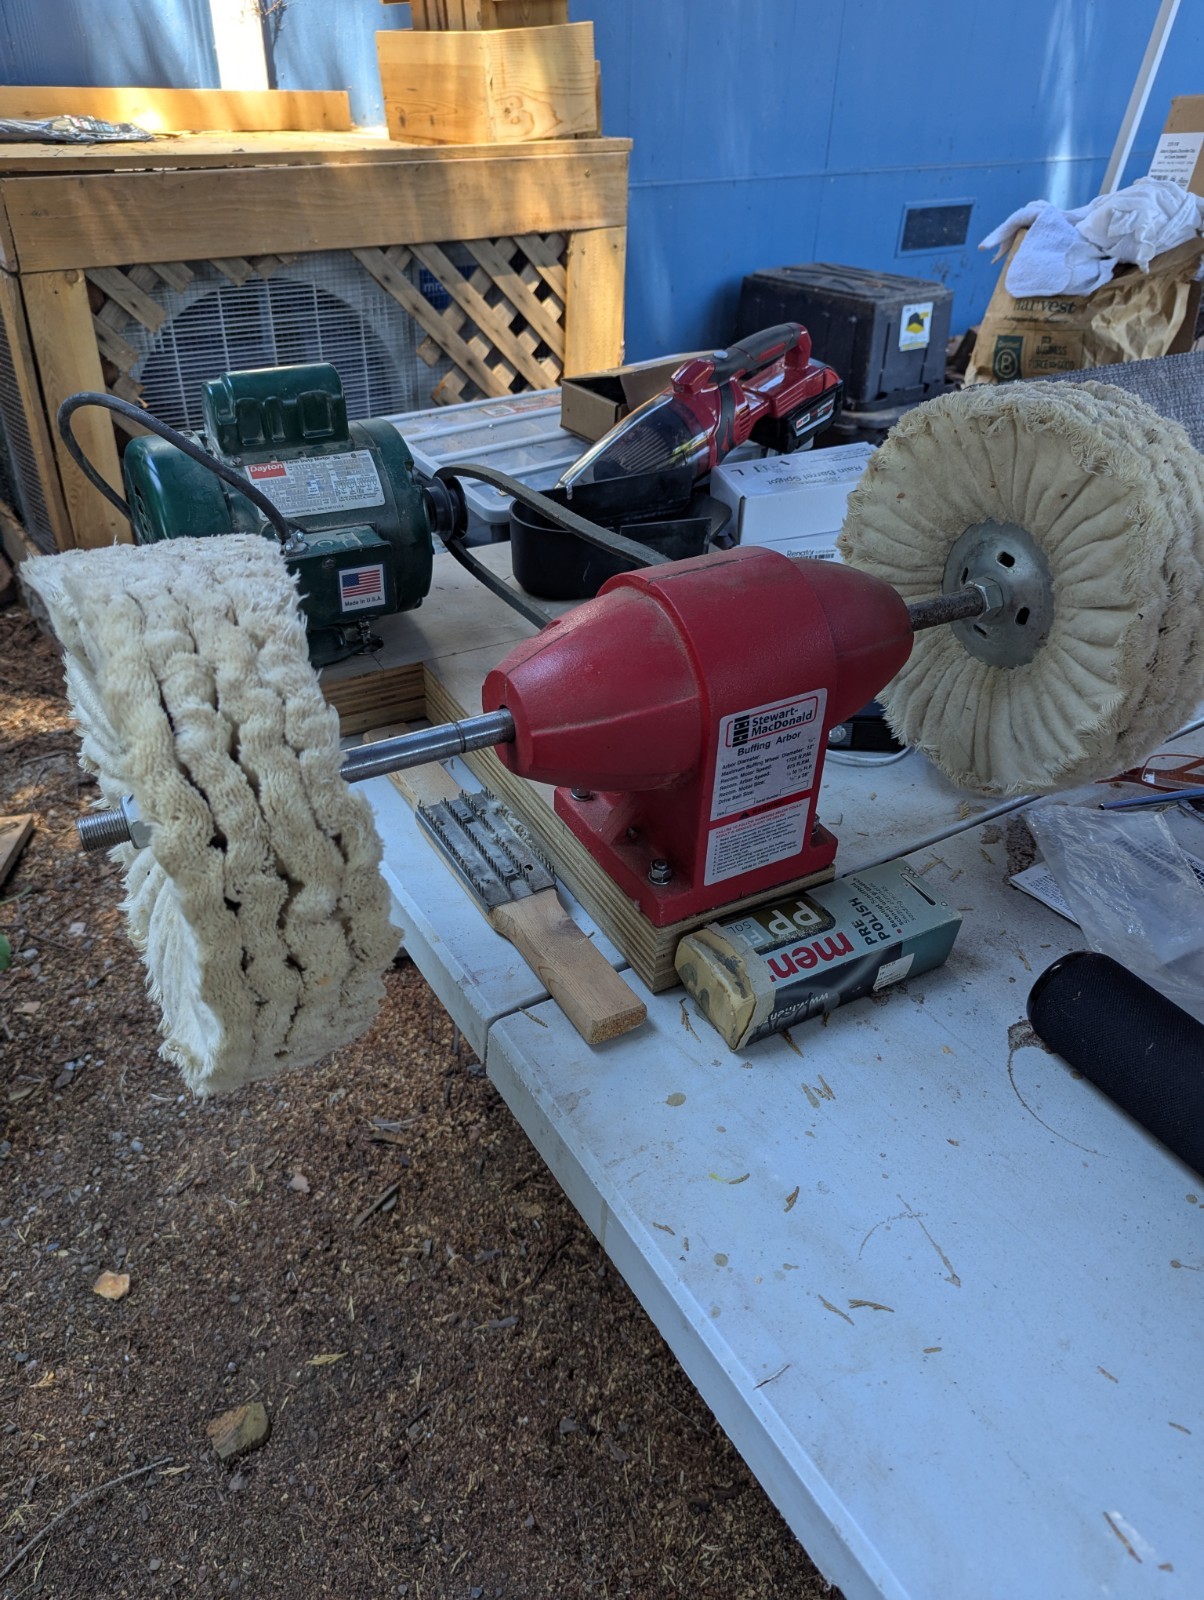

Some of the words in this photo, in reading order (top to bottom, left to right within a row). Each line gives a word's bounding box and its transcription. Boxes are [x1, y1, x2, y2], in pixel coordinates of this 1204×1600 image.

[249, 462, 283, 474] Dayton
[767, 476, 802, 485] Spigot
[803, 470, 836, 480] Barrel
[345, 600, 358, 608] Made
[750, 710, 813, 738] MacDonald
[751, 706, 799, 728] Stewart-
[738, 741, 771, 757] Buffing
[776, 731, 802, 745] Arbor
[768, 900, 822, 935] PP
[849, 897, 891, 940] POLISH
[852, 919, 878, 946] PRE
[767, 932, 854, 982] men
